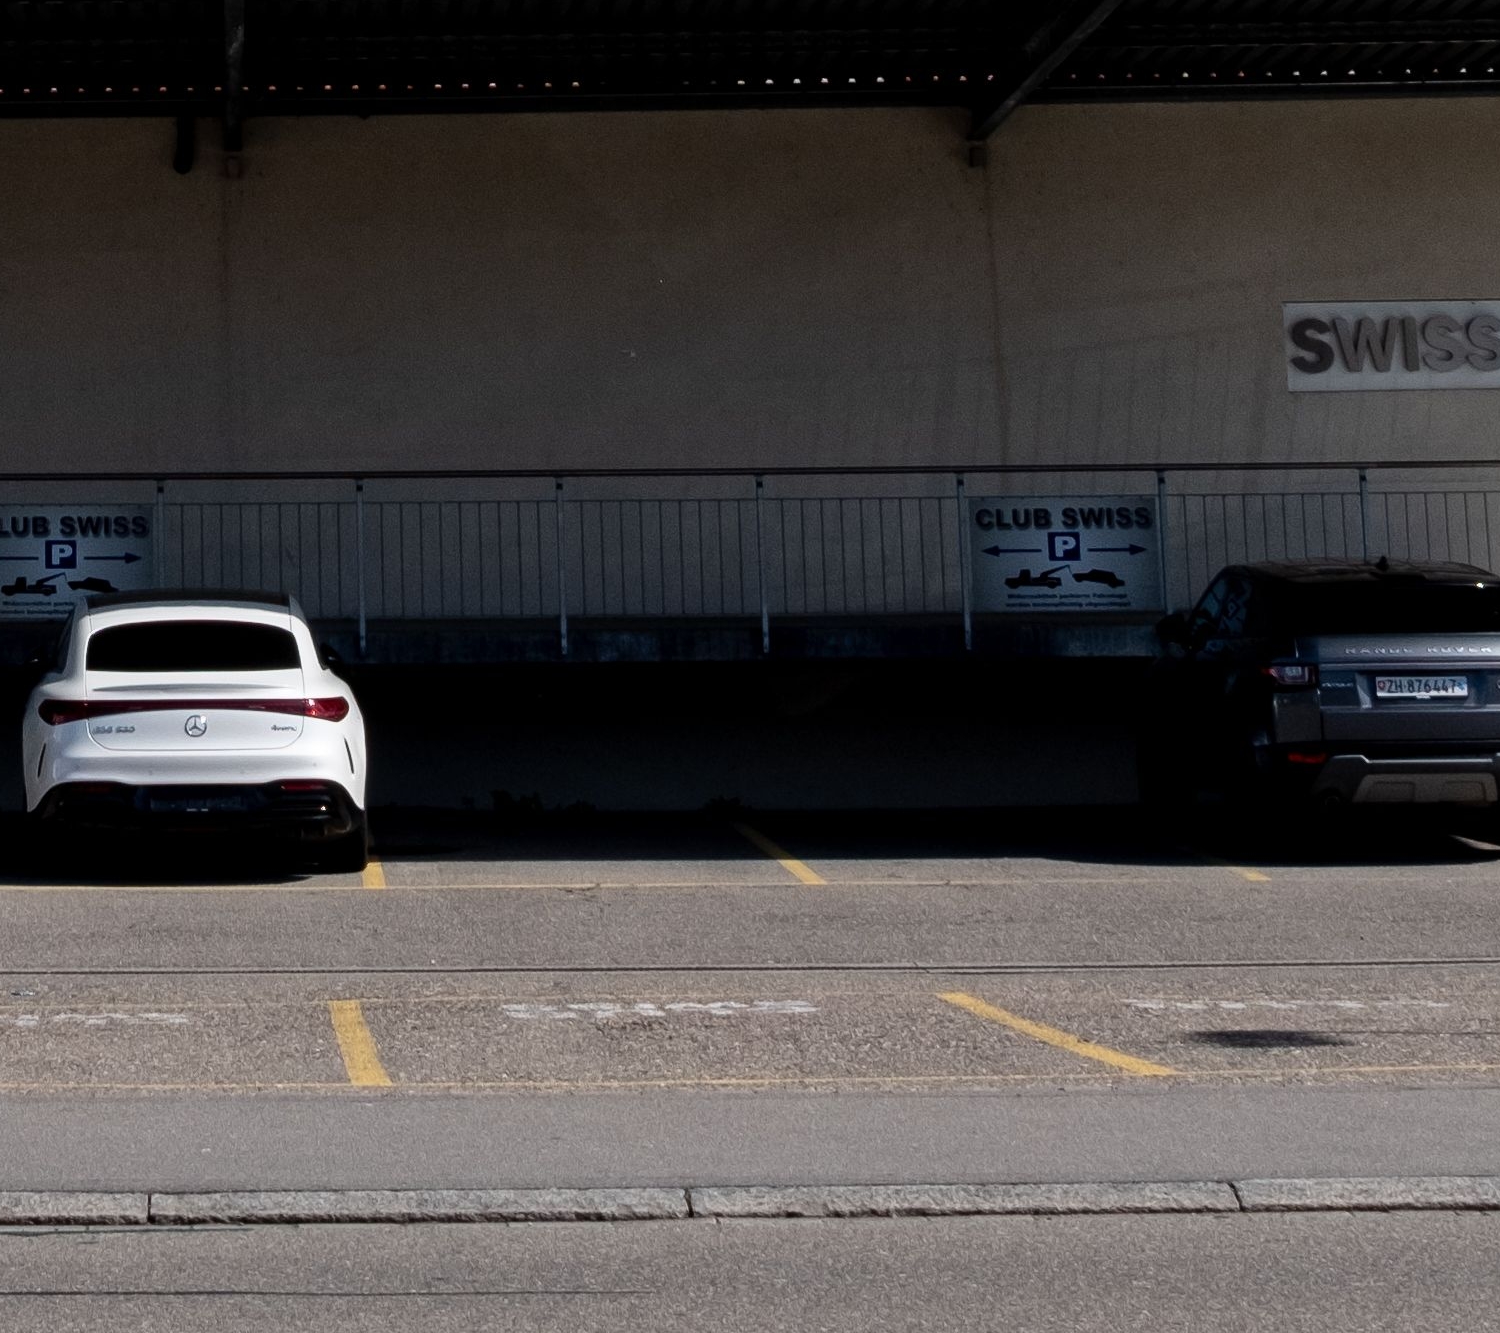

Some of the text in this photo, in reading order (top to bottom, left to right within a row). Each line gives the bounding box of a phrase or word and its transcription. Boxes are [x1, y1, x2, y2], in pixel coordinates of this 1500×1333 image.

[60, 516, 149, 538] SWISS
[975, 507, 1152, 530] CLUB SWISS
[51, 544, 73, 565] P
[1054, 535, 1076, 557] P
